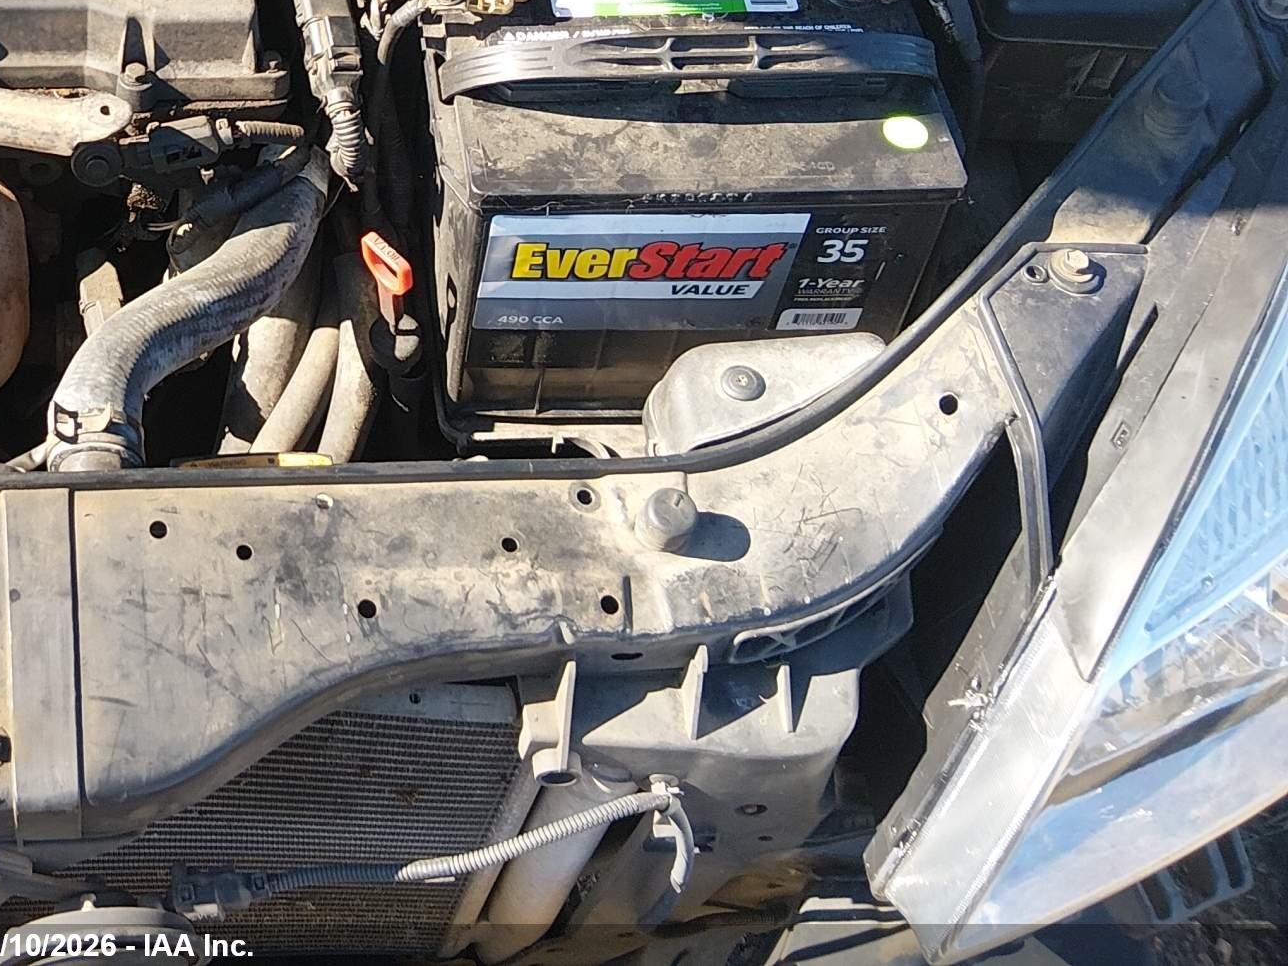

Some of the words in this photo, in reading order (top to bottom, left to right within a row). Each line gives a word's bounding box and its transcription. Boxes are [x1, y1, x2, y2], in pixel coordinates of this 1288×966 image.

[816, 239, 869, 263] 35
[511, 240, 786, 281] EverStart
[671, 283, 751, 296] VALUE
[798, 278, 865, 288] 1-Year
[497, 314, 529, 324] 490
[533, 314, 564, 324] CCA
